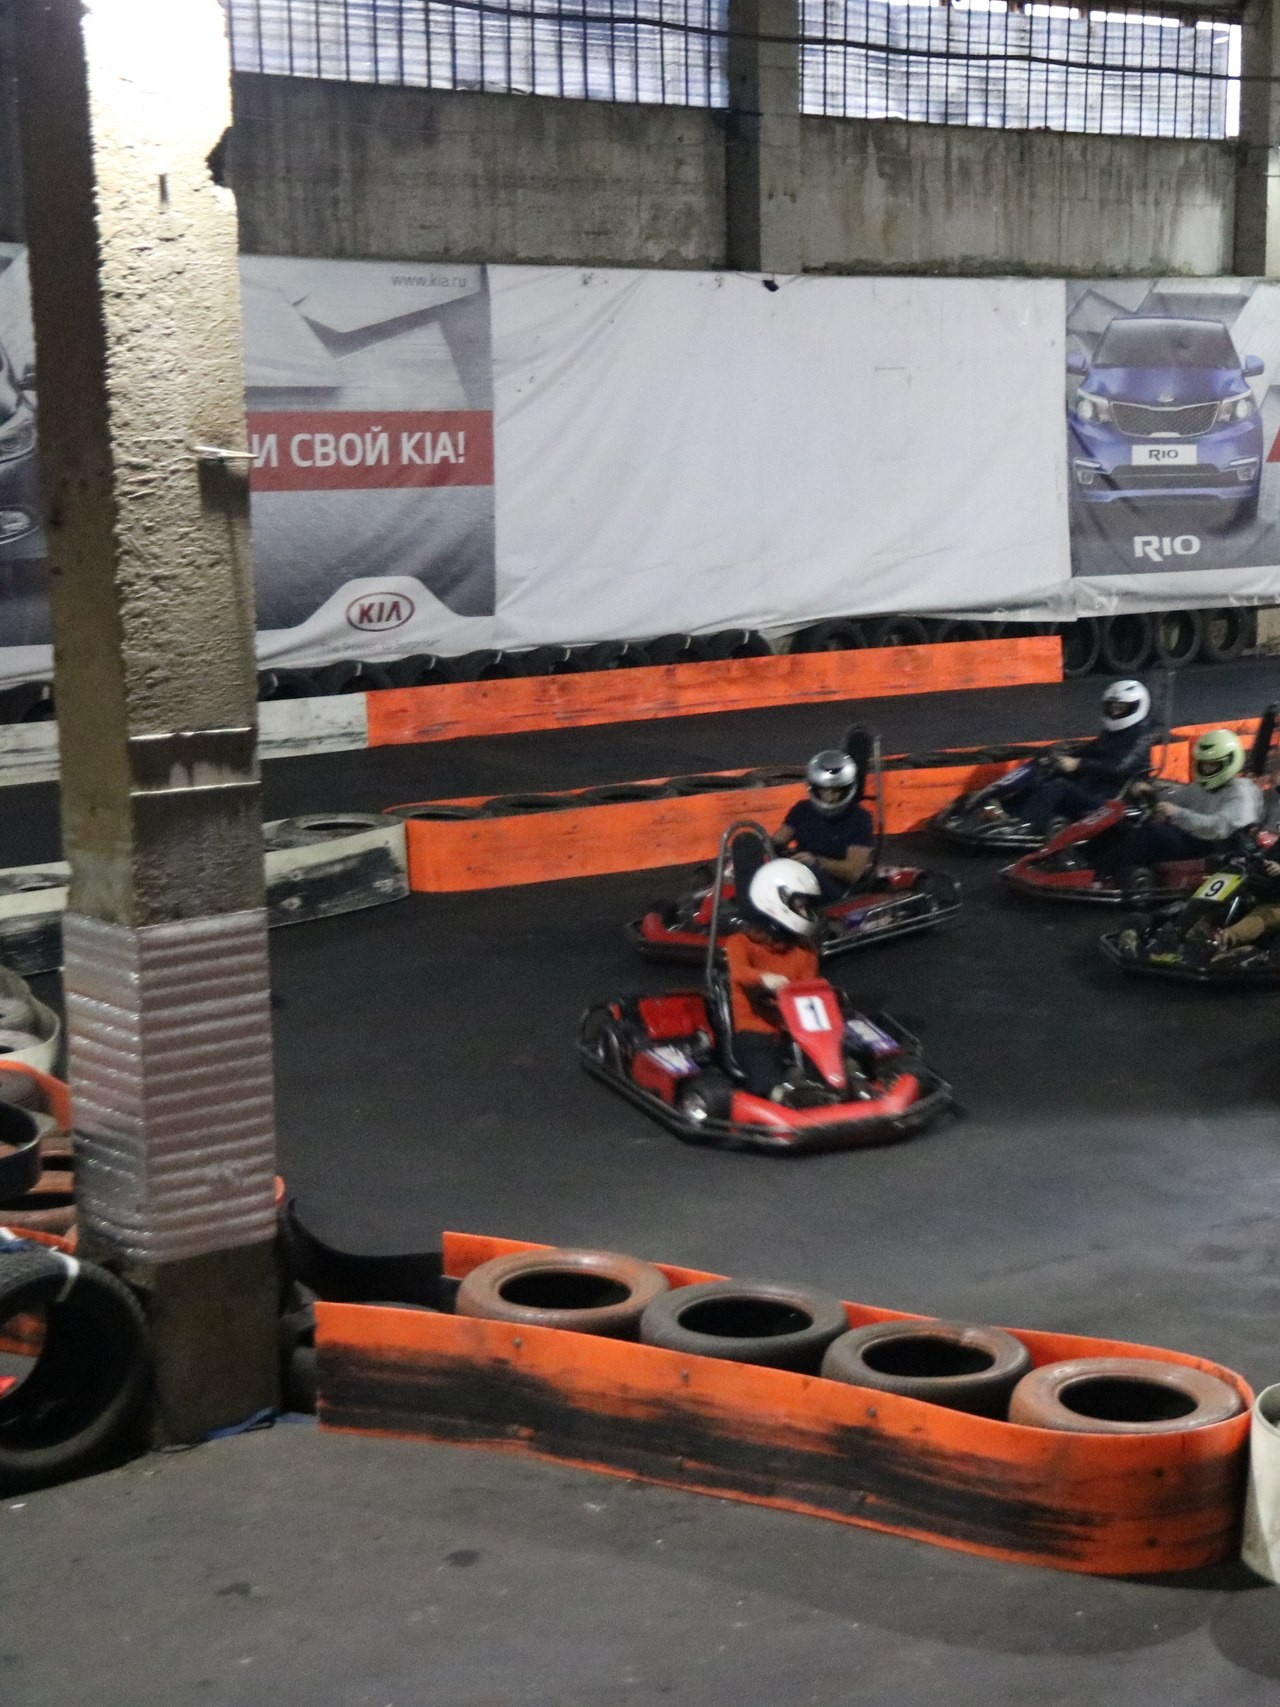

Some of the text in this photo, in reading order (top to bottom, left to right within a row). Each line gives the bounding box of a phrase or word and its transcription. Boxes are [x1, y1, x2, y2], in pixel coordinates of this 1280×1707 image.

[251, 425, 465, 468] И СВОЙ KIA!
[1148, 449, 1179, 461] RIO
[1133, 534, 1201, 562] RIO
[358, 600, 403, 624] KIA
[1204, 879, 1225, 897] 9
